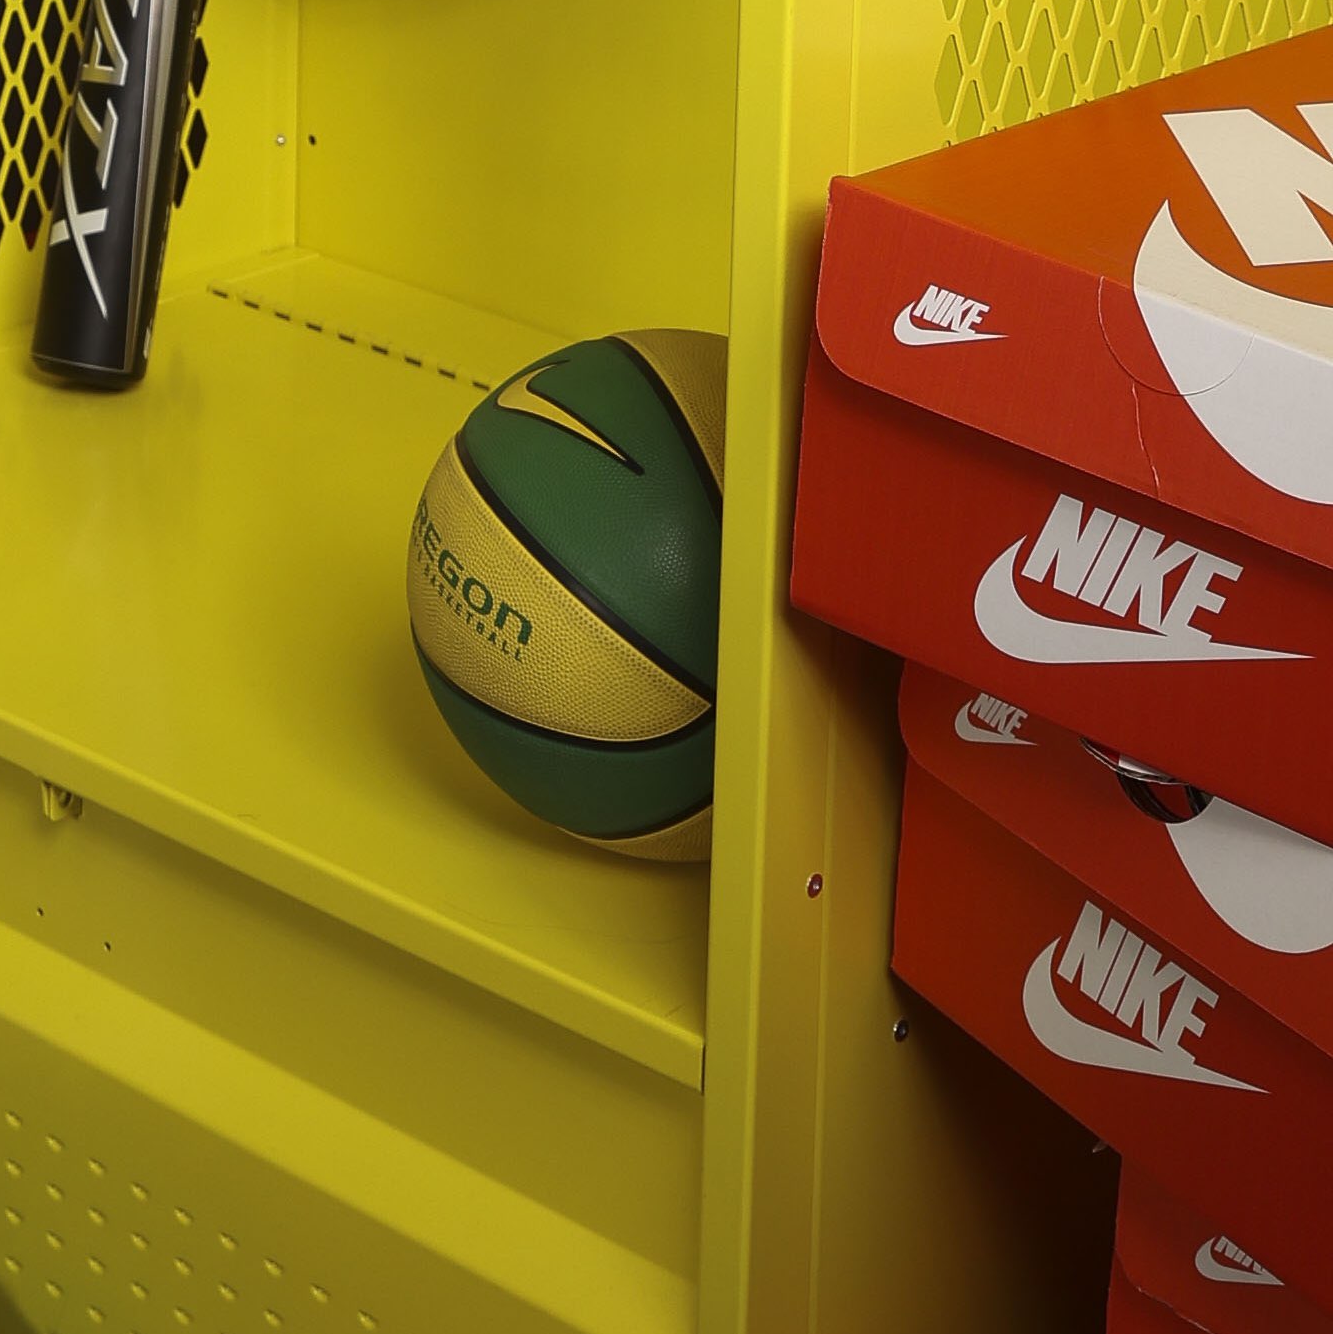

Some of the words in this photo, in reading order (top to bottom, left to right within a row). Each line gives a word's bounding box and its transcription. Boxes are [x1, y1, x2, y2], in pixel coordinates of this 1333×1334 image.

[912, 284, 990, 333] NIKE
[1020, 493, 1244, 643] NIKE
[971, 692, 1029, 738] NIKE
[1056, 899, 1220, 1063] NIKE
